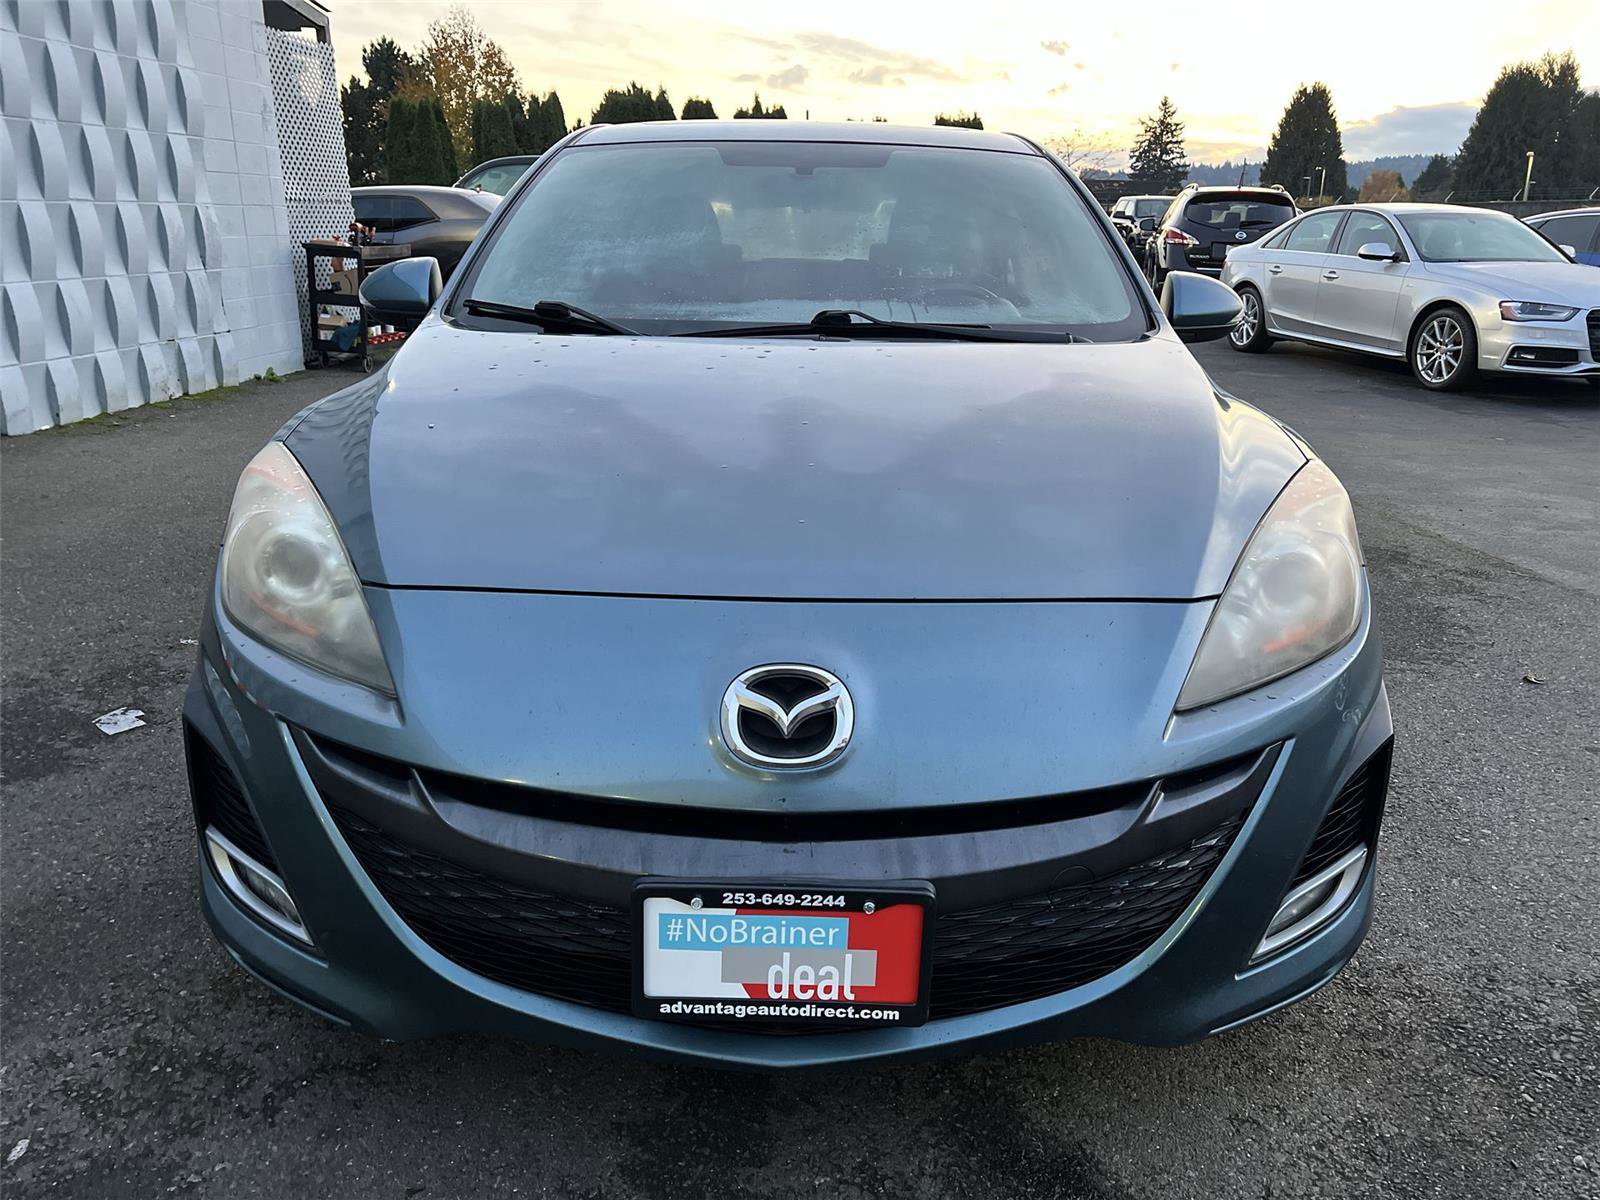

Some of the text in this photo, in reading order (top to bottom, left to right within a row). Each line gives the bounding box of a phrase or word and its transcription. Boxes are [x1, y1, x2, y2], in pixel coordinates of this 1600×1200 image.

[722, 893, 846, 907] 253-649-2244
[667, 918, 839, 946] #NoBrainer
[767, 952, 855, 1000] deal
[659, 1001, 900, 1020] advantageautodirect.com
